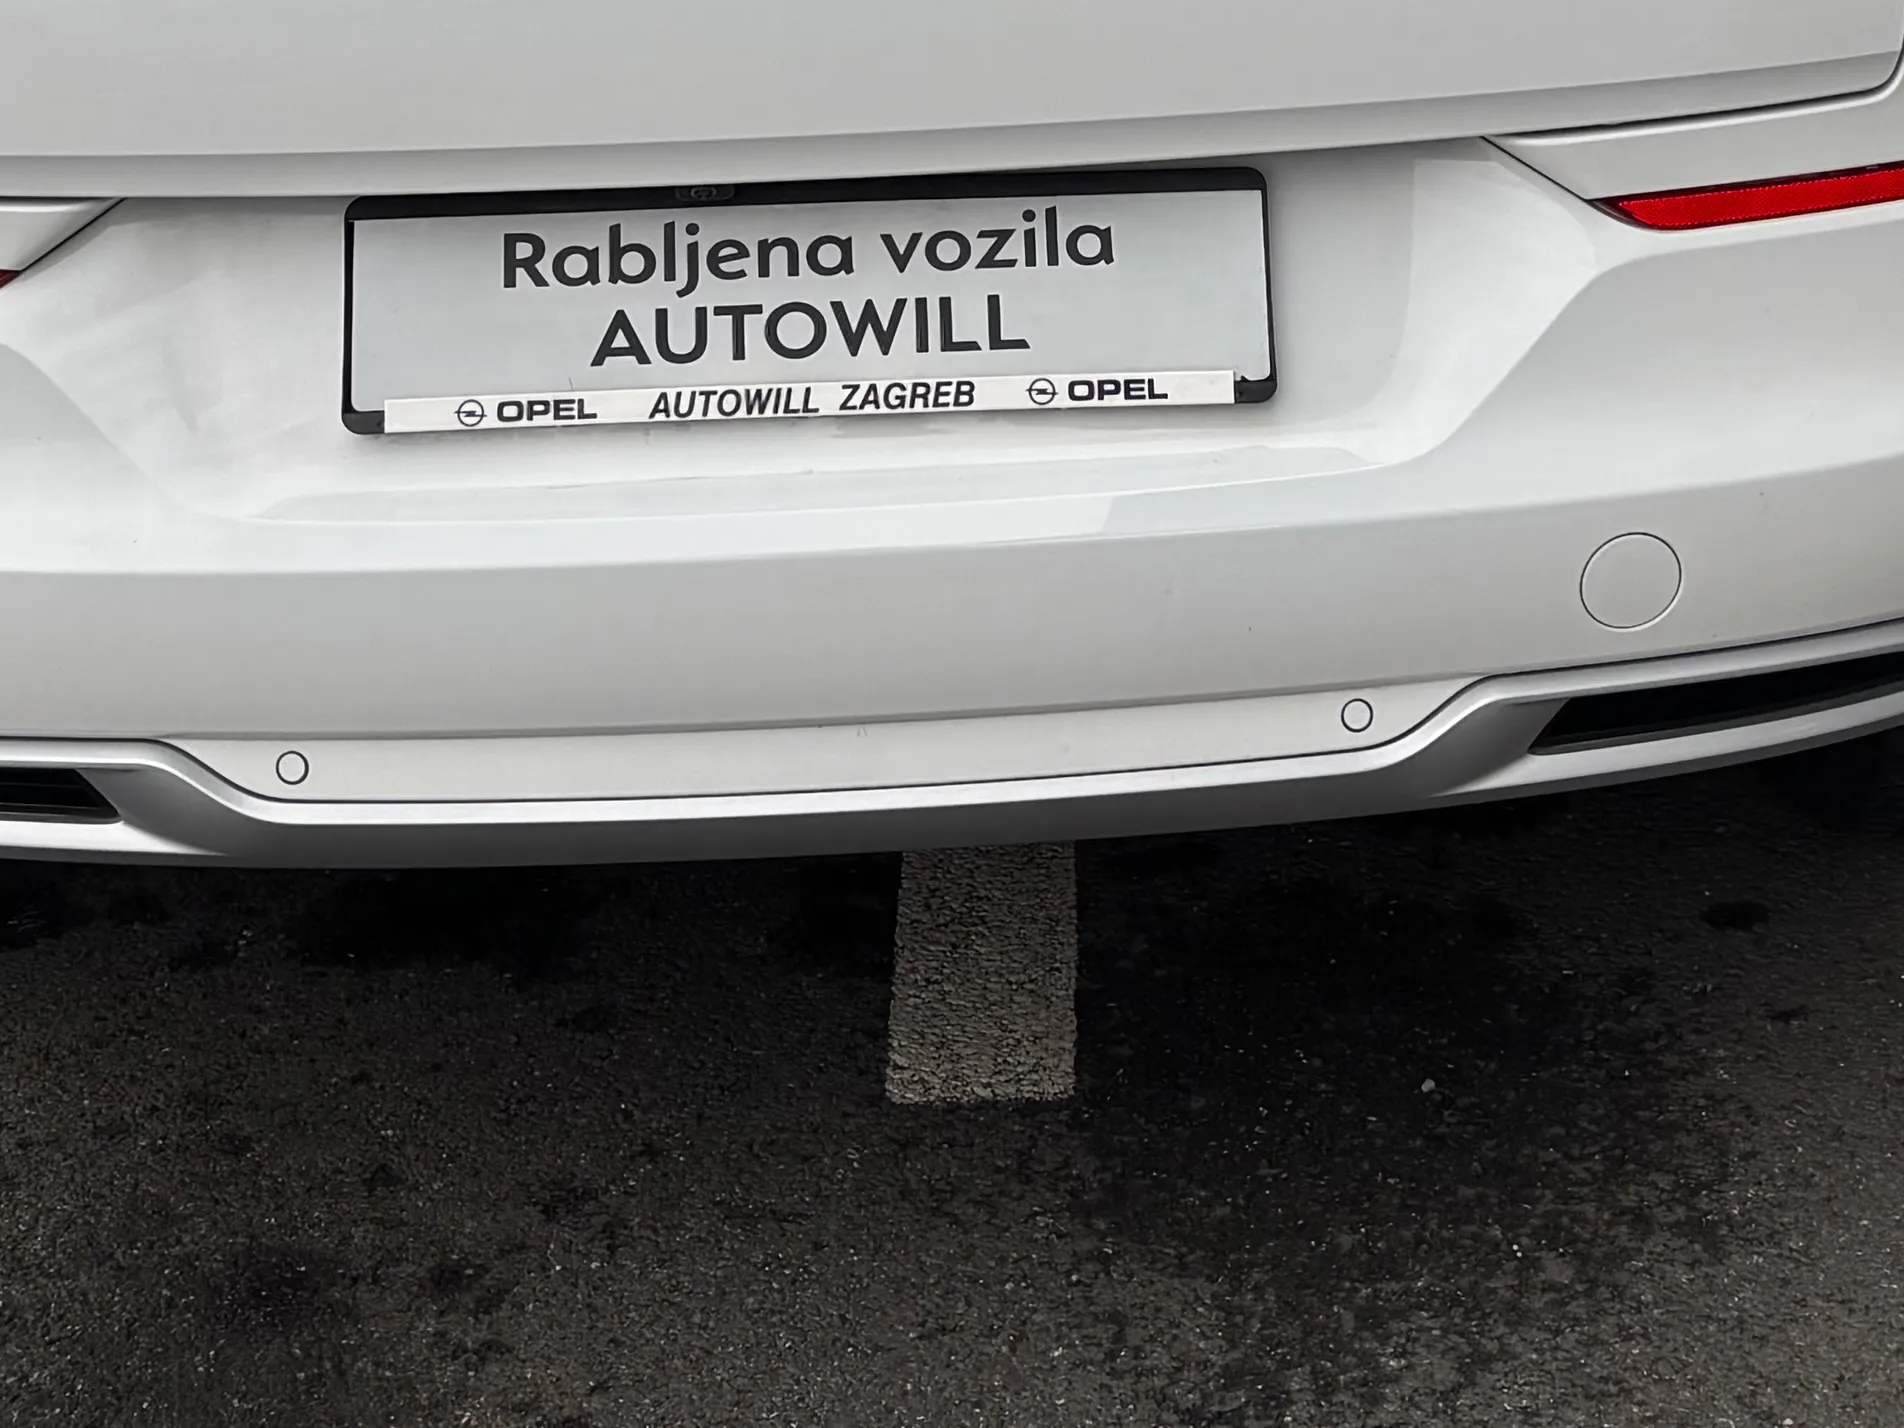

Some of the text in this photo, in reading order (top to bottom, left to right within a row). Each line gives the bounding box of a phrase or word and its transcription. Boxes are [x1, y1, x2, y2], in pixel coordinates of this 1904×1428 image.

[502, 206, 1116, 298] Rabljena vozila
[590, 294, 1031, 367] AUTOWILL
[496, 377, 1169, 424] OPEL AUTOWILL ZAGREB OPEL
